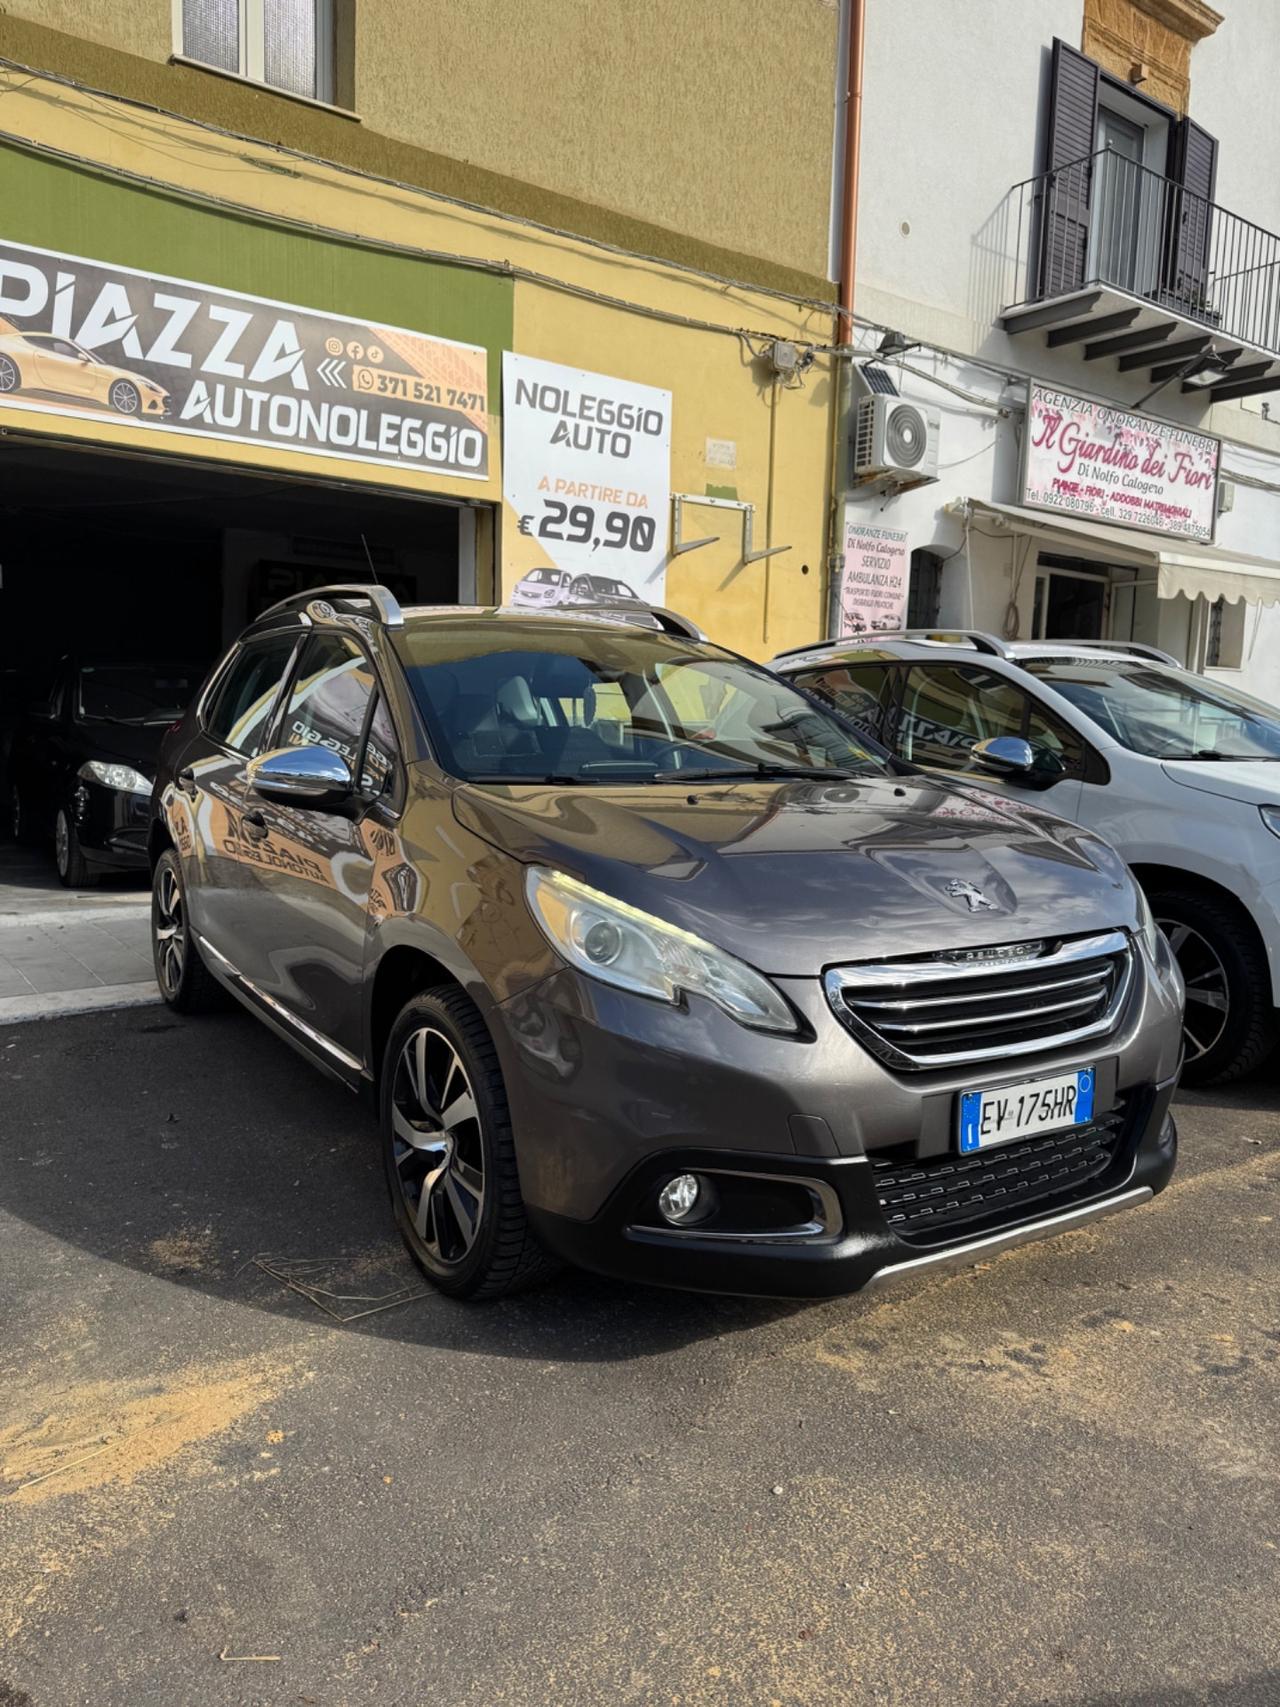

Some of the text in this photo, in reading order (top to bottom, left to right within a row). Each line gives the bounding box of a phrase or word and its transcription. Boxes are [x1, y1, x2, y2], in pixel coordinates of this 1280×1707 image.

[0, 259, 310, 391] PIAZZA
[377, 374, 486, 412] 371 521 7471
[514, 378, 664, 436] NOLEGGIO
[180, 379, 483, 468] AUTONOLEGGIO
[549, 419, 632, 459] AUTO
[1032, 389, 1218, 452] AGENZIA ONORANZE FUNEBRI
[1032, 413, 1213, 490] Il Giardino dei Fiori
[537, 474, 649, 509] A PARTIRE DA
[1026, 487, 1041, 501] Tel.
[1077, 462, 1164, 495] Di Nolfo Calogero
[1110, 491, 1143, 507] ADDOBBI
[516, 498, 656, 552] € 29,90
[846, 571, 889, 587] AMBULANZA
[861, 555, 891, 570] SERVIZIO
[980, 1085, 1077, 1136] EV 175HR
